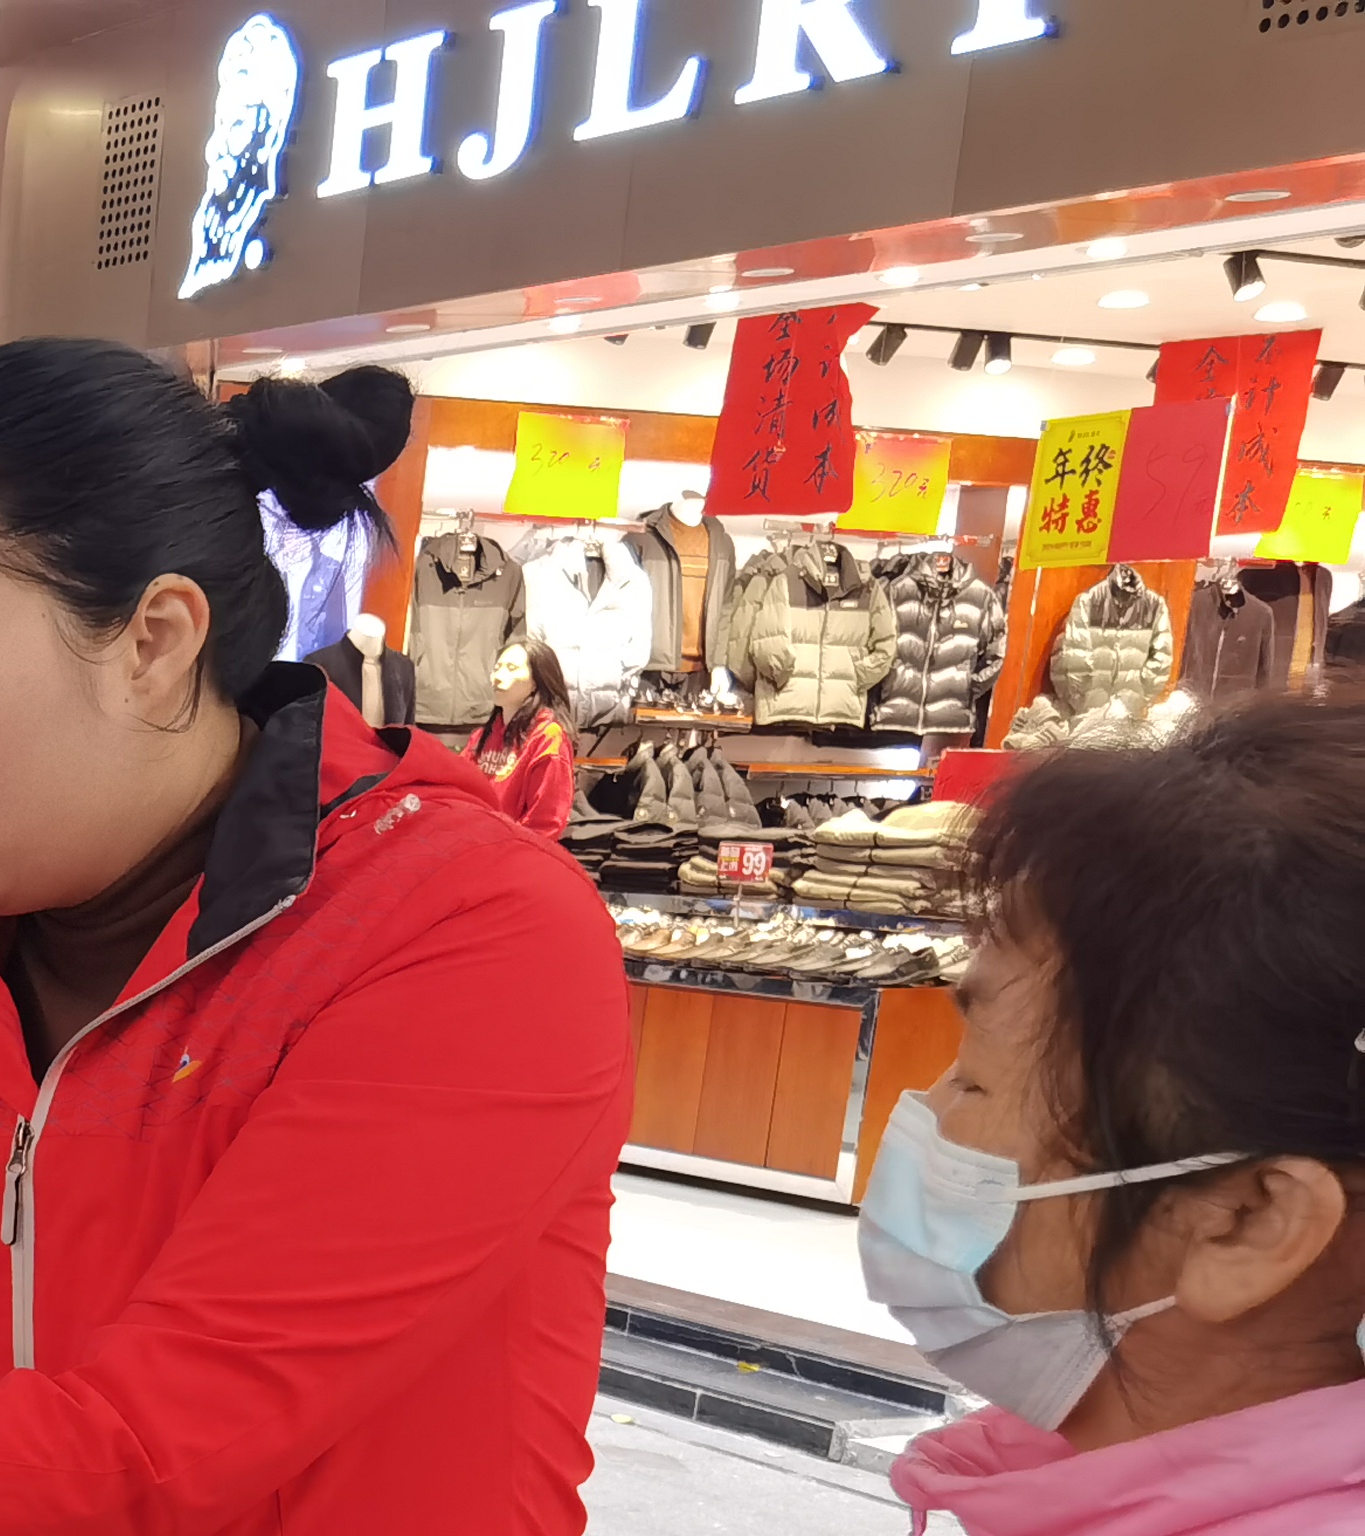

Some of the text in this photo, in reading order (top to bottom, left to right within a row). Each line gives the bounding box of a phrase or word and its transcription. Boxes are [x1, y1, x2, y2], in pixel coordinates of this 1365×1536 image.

[1044, 443, 1113, 490] 年终
[1039, 489, 1102, 535] 特惠
[742, 851, 766, 875] 99
